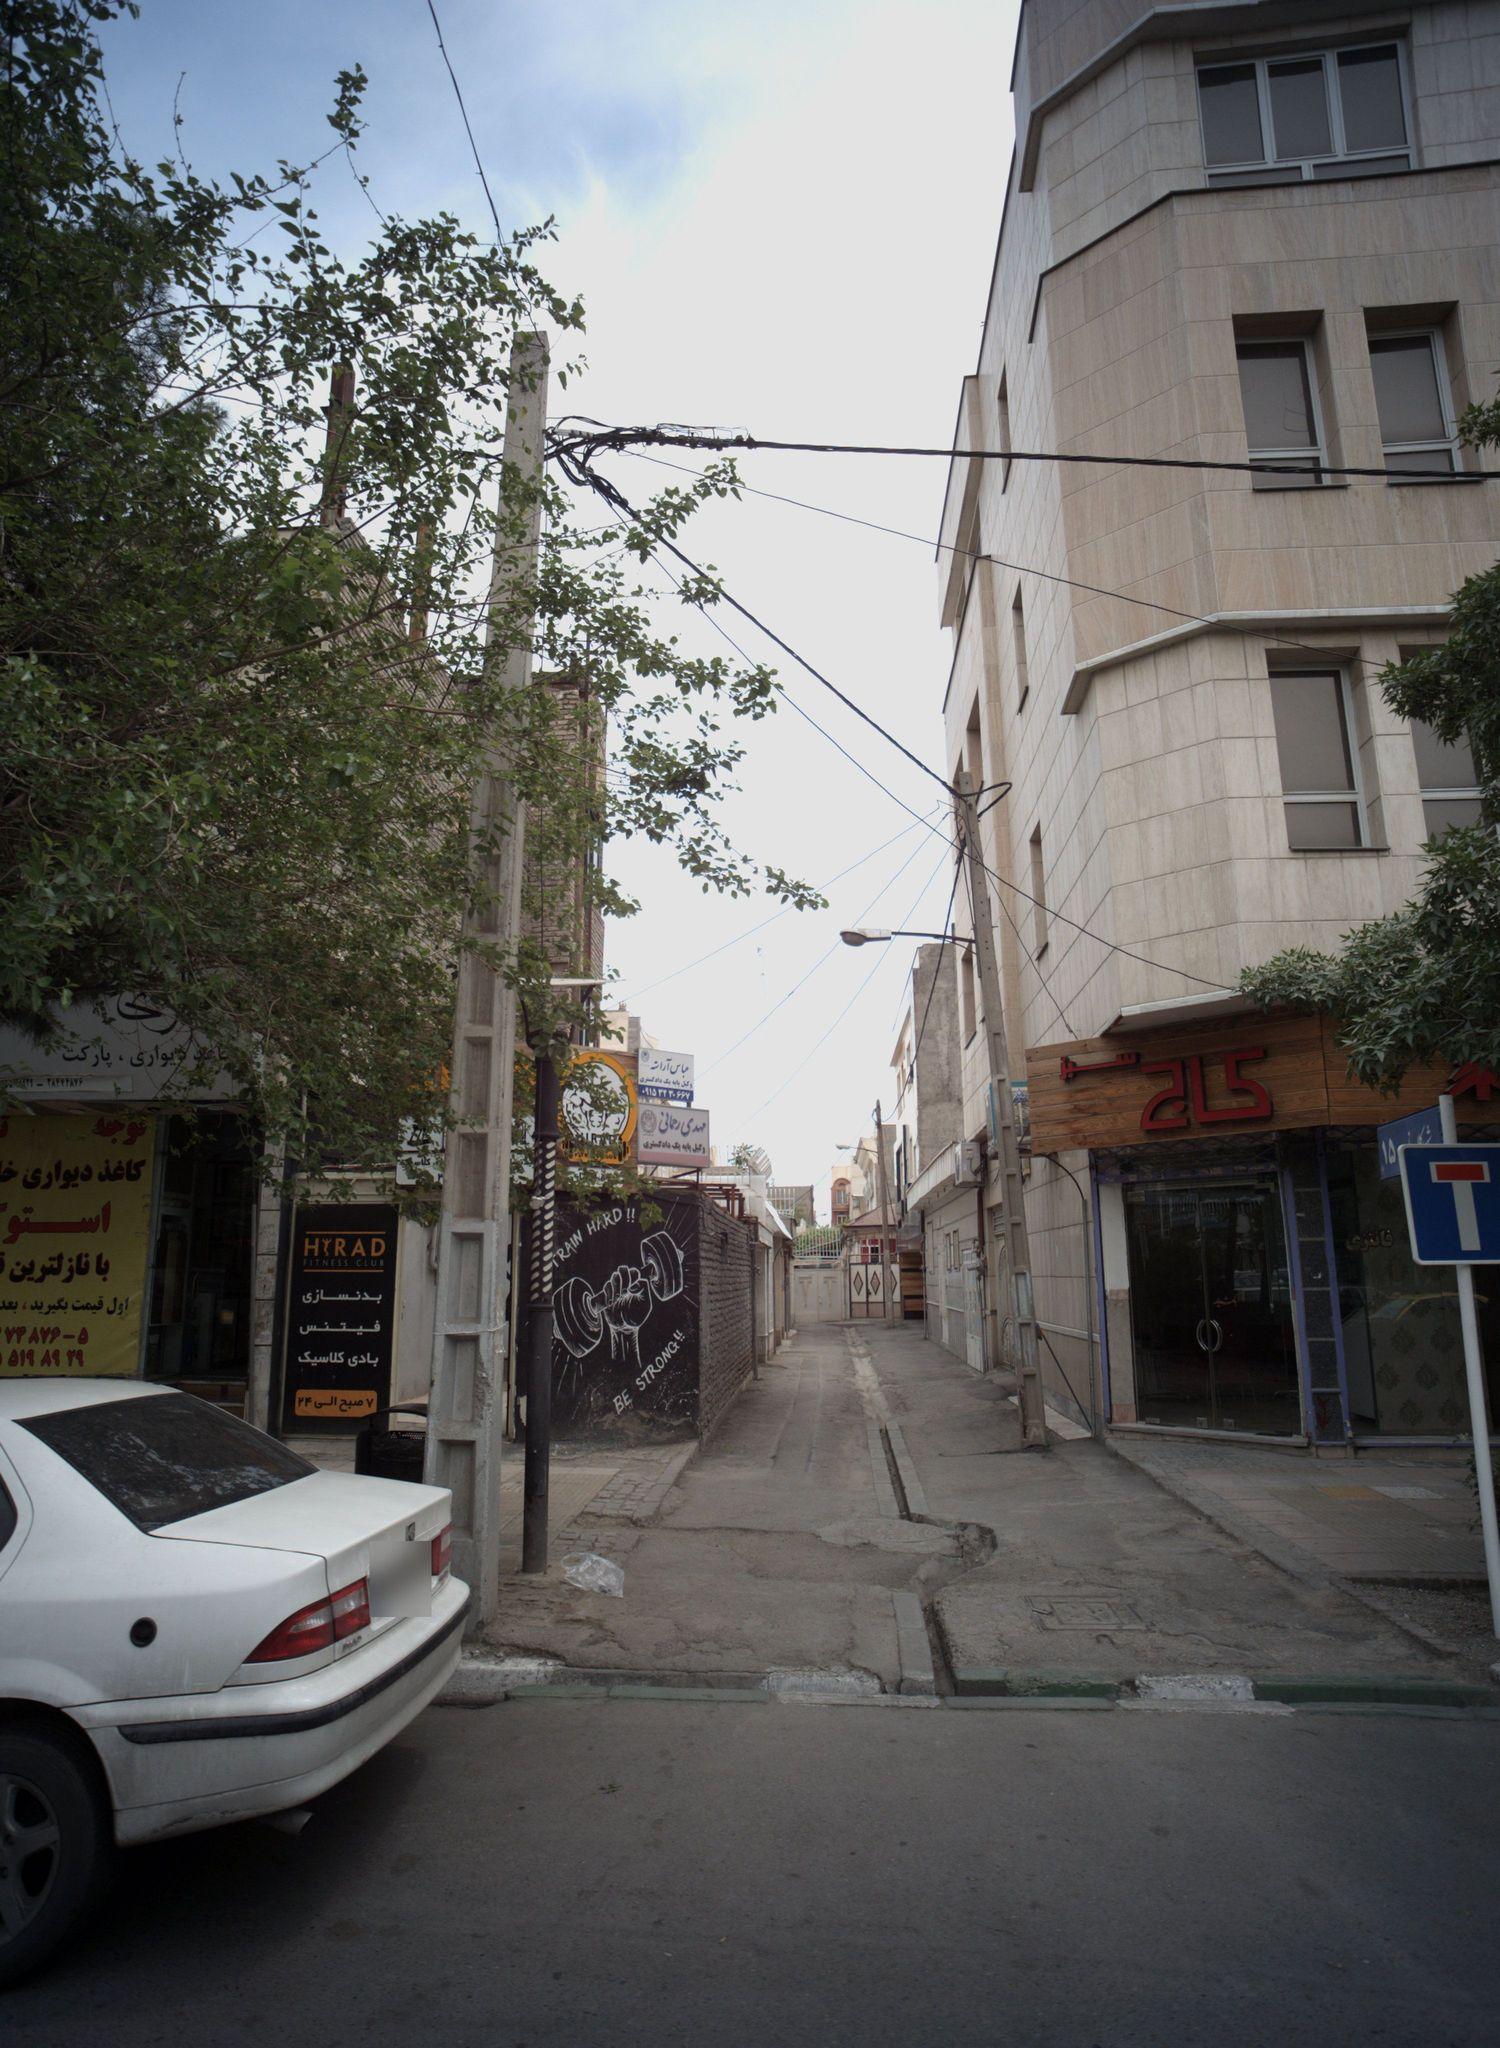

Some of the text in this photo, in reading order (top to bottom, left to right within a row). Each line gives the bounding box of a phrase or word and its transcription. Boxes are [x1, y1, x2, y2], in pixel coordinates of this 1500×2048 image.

[62, 1045, 111, 1068] پارکت
[680, 1118, 706, 1137] مهدی
[643, 1140, 671, 1150] دادگستری
[22, 1160, 92, 1189] دیواری
[97, 1158, 146, 1182] کاغذ
[0, 1200, 111, 1244] استو
[586, 1208, 622, 1236] HARD
[9, 1251, 90, 1283] نازلترین
[96, 1252, 110, 1281] با
[303, 1258, 384, 1267] FITNESS CLUB
[30, 1297, 68, 1315] بگیرید
[71, 1296, 104, 1314] قیمت
[106, 1296, 129, 1315] اول
[302, 1289, 382, 1304] بدنسازی
[299, 1320, 381, 1335] فیتنس
[297, 1350, 379, 1367] بادی کلاسیک
[297, 1396, 374, 1412] ۷ صبح الی ۲۴
[613, 1388, 634, 1415] BE
